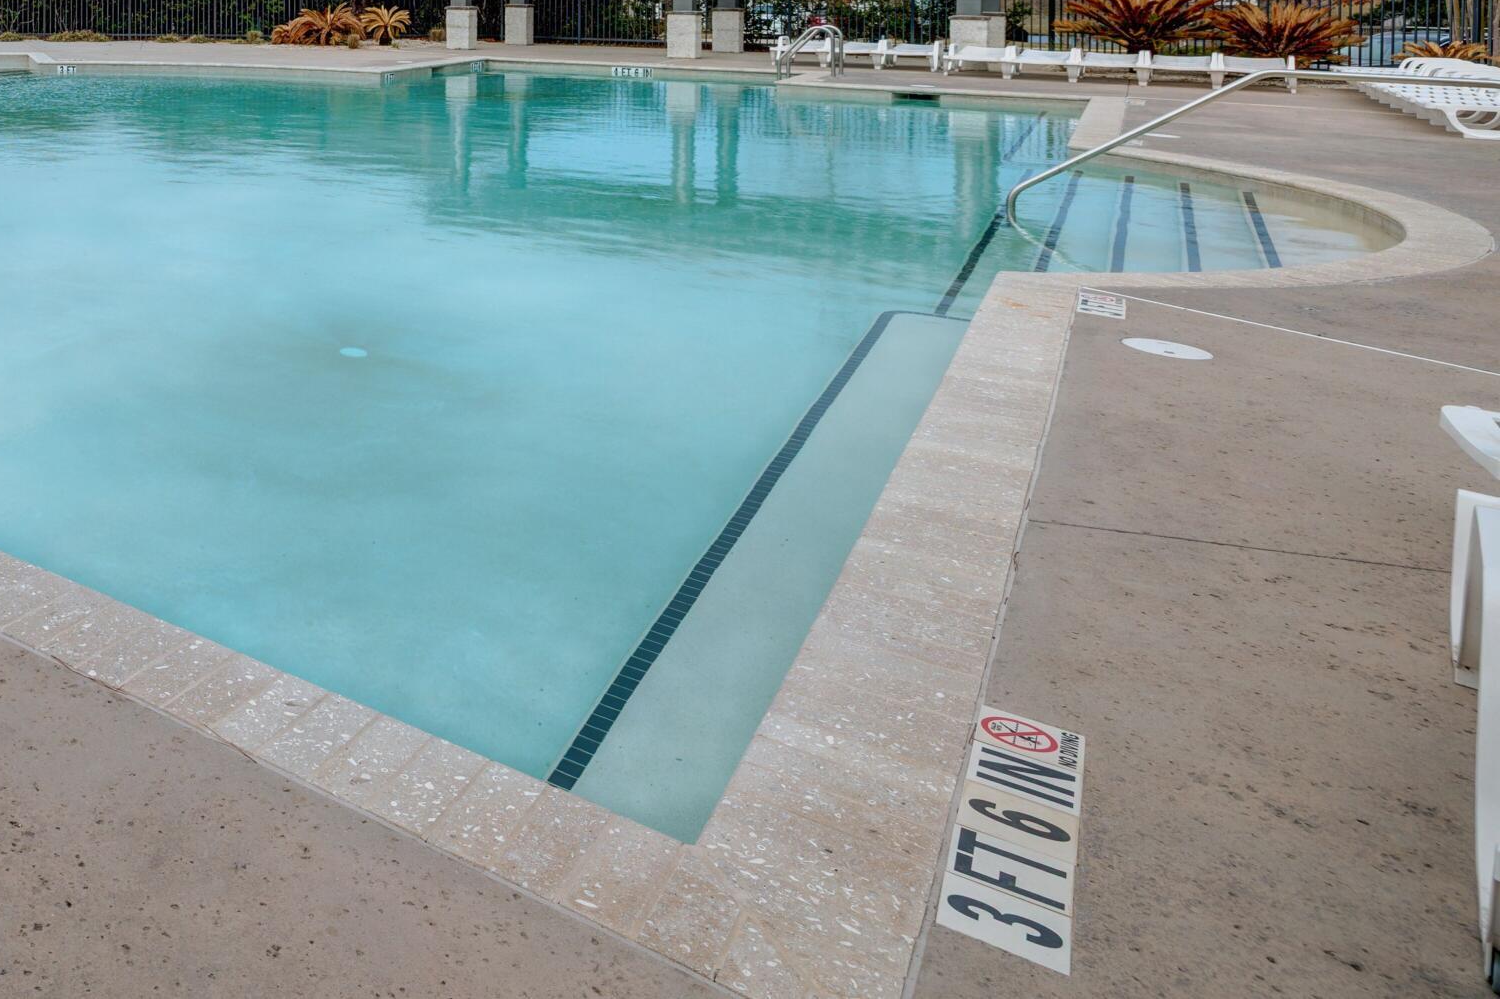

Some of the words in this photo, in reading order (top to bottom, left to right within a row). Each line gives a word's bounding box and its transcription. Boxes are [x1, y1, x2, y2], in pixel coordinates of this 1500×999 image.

[1058, 755, 1077, 770] NO
[1059, 732, 1080, 758] DIVING
[975, 746, 1076, 809] IN
[968, 798, 1071, 843] 6
[953, 827, 1067, 911] FT
[947, 893, 1064, 949] 3
